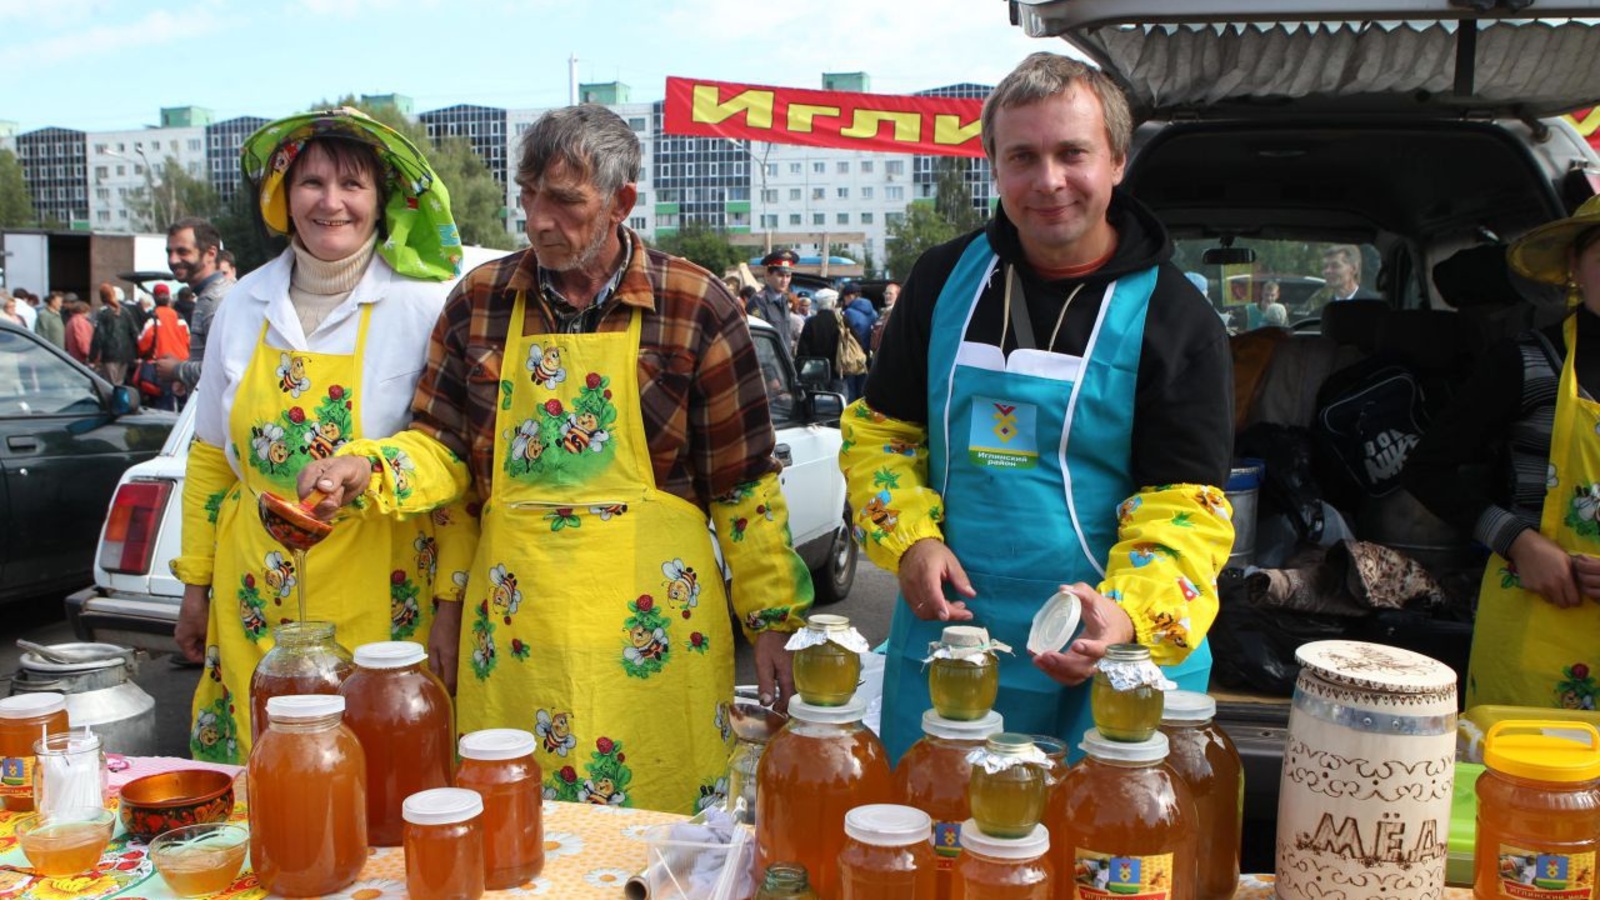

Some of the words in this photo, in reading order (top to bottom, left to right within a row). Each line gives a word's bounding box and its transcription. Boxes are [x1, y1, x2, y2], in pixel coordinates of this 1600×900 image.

[977, 451, 1027, 462] Иглинский
[987, 459, 1016, 467] район
[1311, 812, 1446, 863] МЁД
